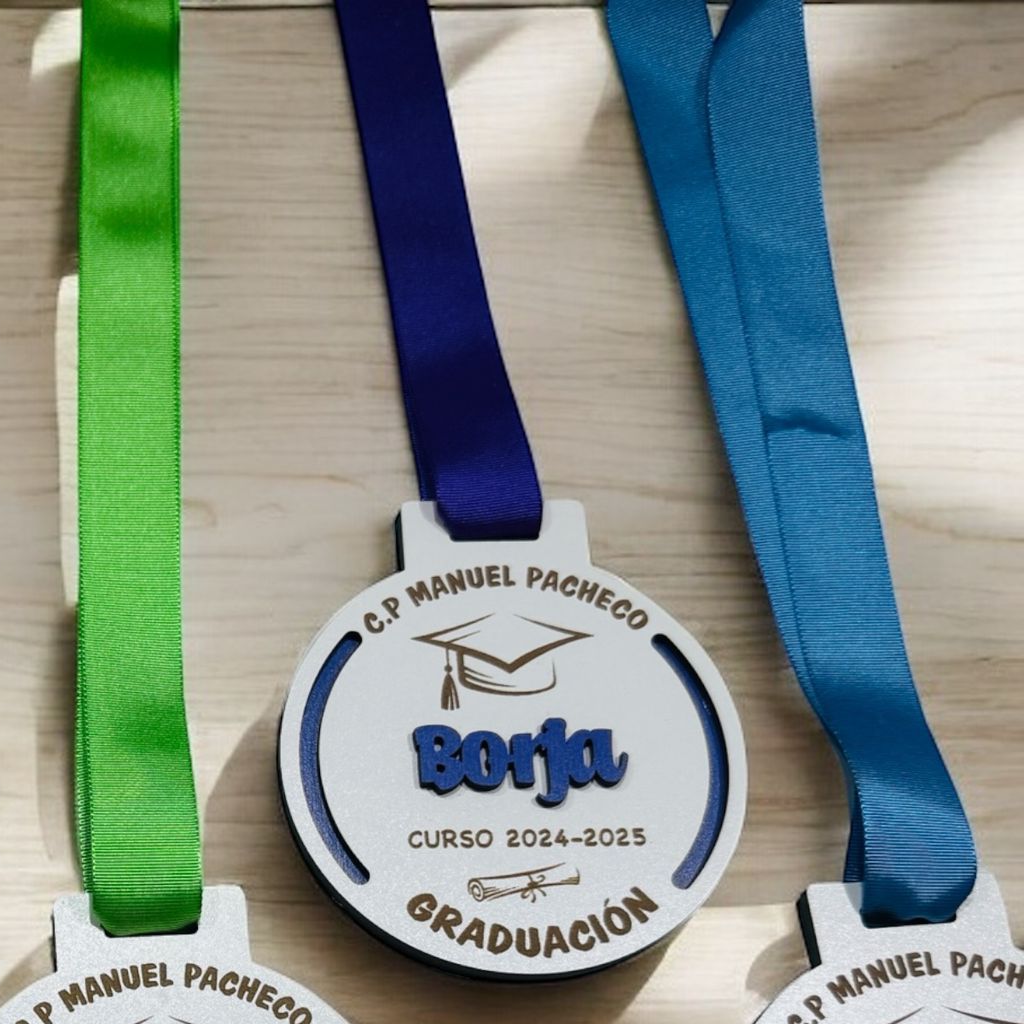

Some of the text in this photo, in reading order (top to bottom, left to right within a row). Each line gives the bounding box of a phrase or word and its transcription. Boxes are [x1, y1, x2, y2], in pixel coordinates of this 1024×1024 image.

[362, 565, 649, 635] C.P MANUEL PACHECO
[413, 717, 629, 807] Borja
[407, 827, 646, 848] CURSO 2024-2025
[406, 886, 659, 958] GRADUACIÓN
[58, 962, 174, 1013] MANUEL
[828, 951, 941, 1004] MANUEL
